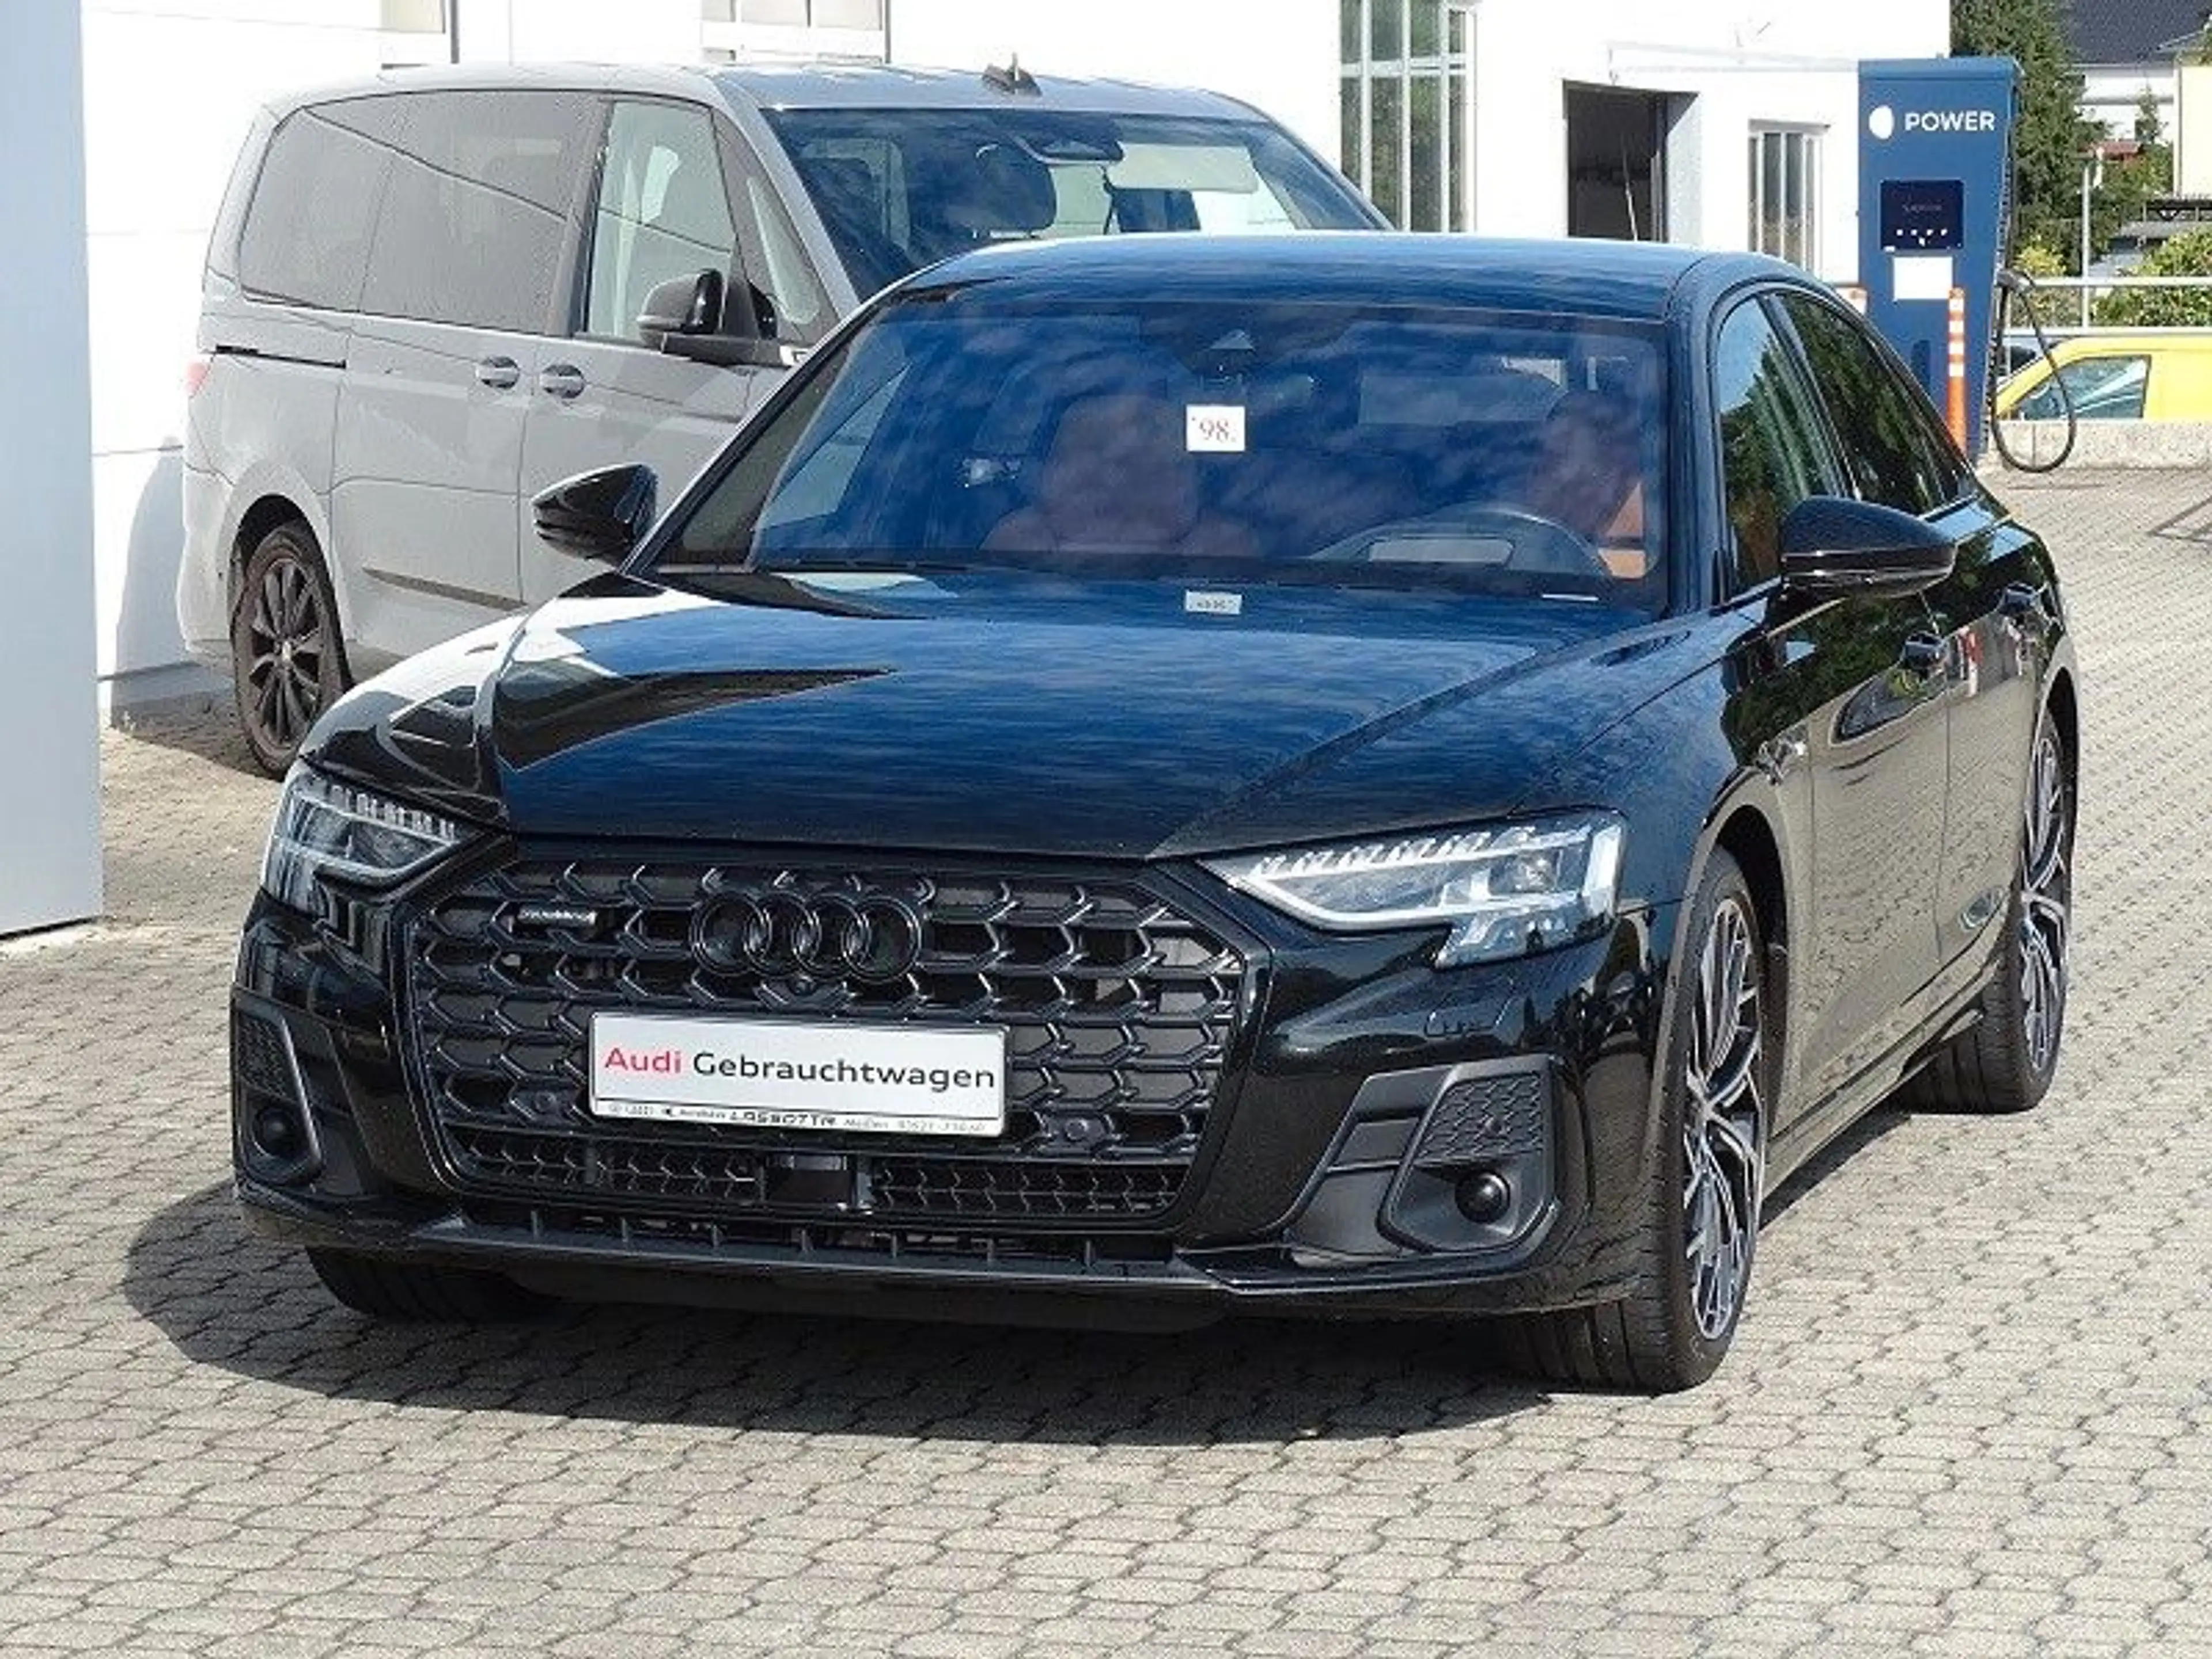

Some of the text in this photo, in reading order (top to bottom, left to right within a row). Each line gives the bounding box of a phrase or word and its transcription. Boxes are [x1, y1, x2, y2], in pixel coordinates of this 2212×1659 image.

[1904, 110, 1995, 131] POWER
[605, 1047, 994, 1093] Audi Gebrauchtwagen
